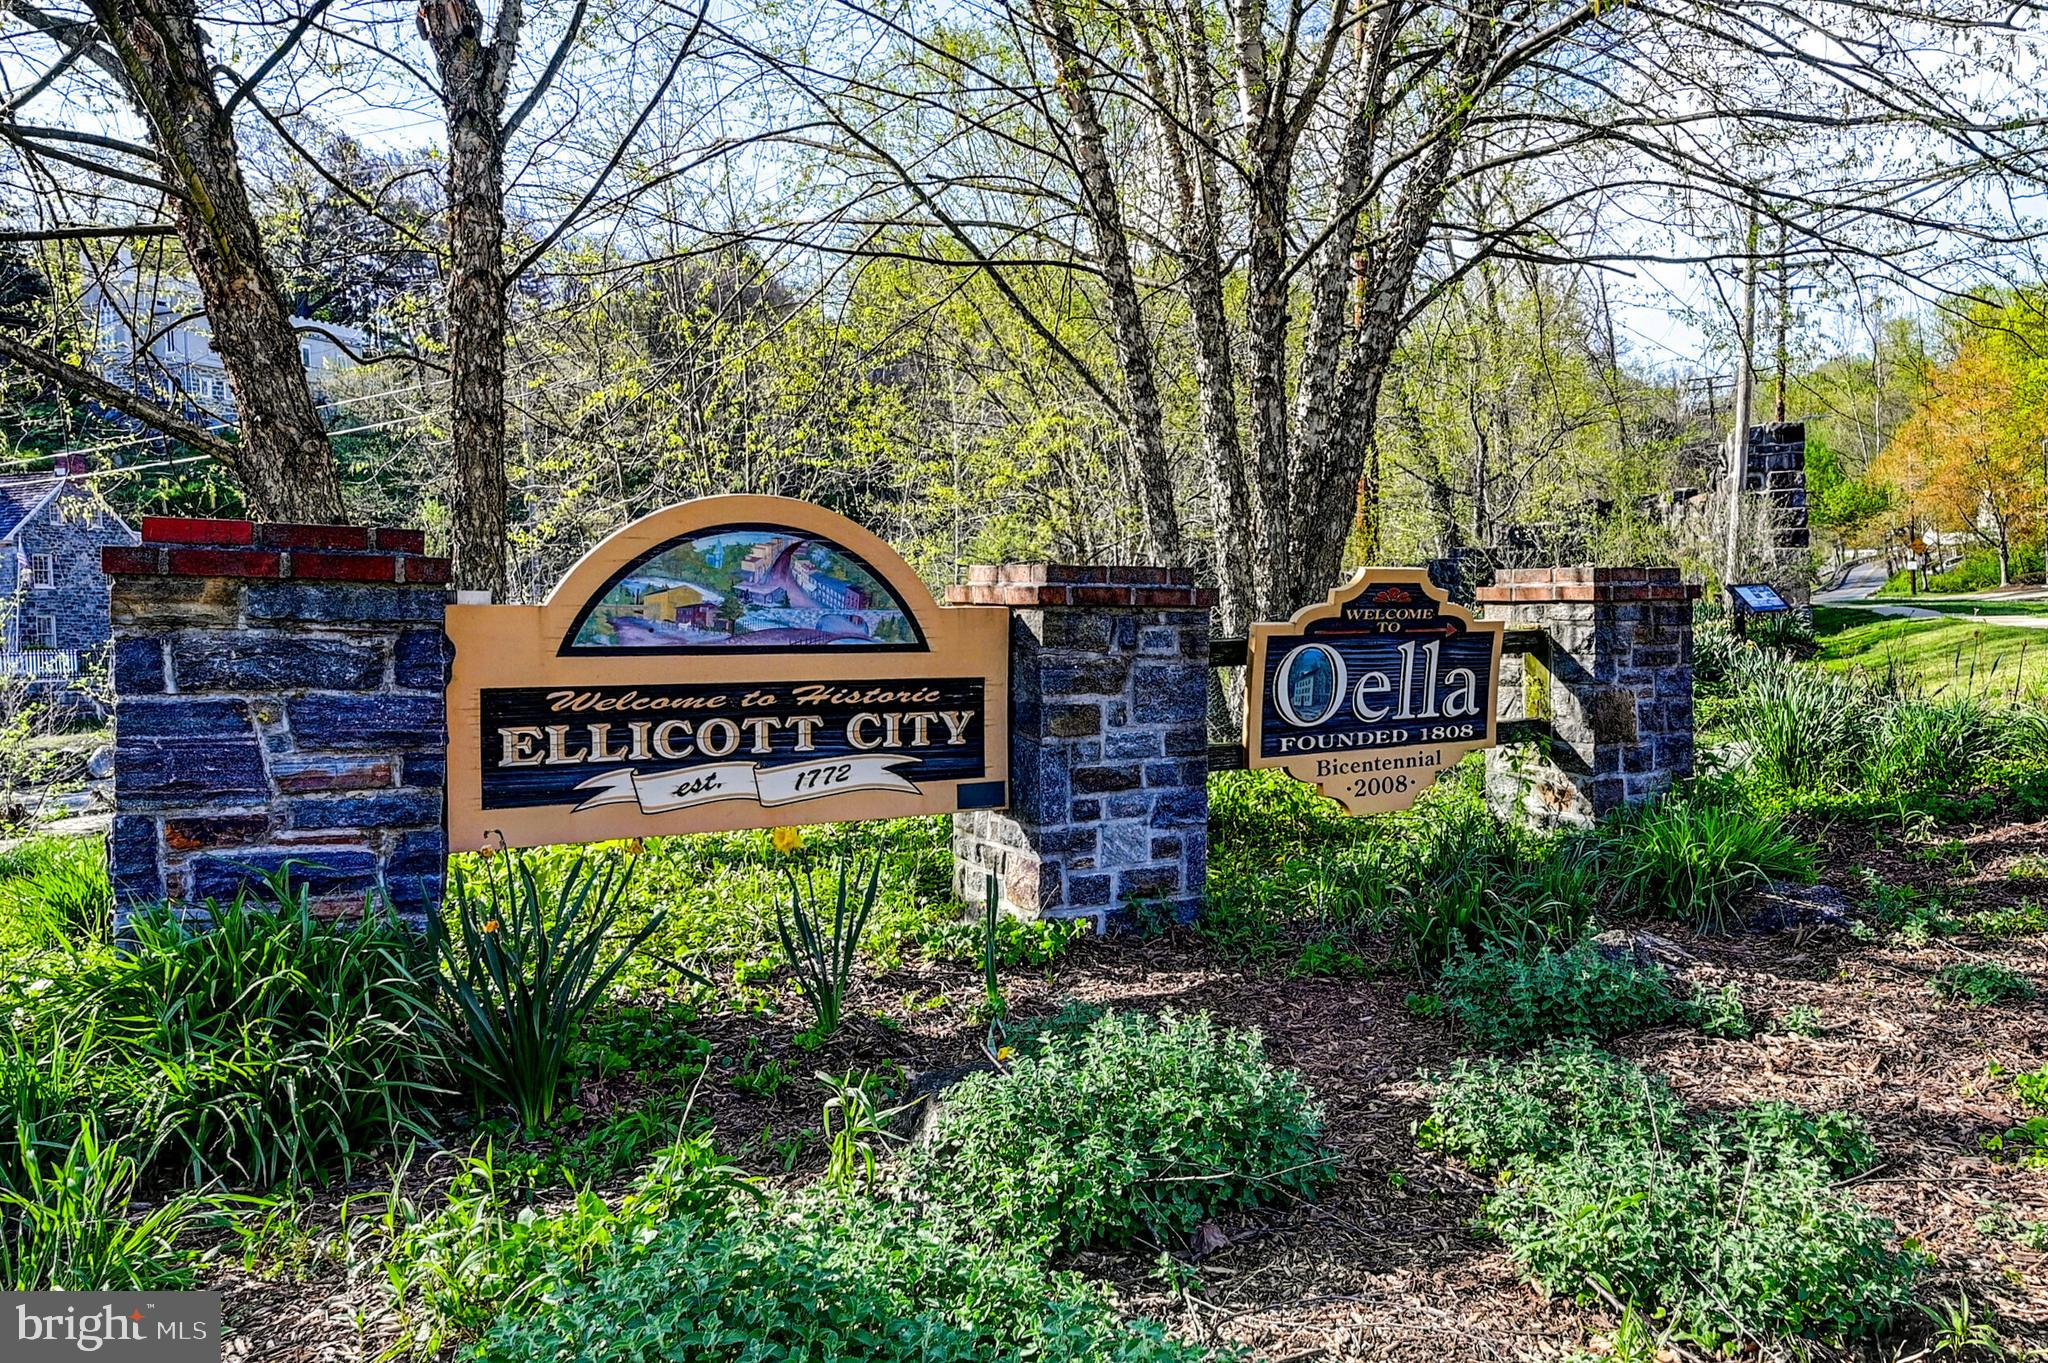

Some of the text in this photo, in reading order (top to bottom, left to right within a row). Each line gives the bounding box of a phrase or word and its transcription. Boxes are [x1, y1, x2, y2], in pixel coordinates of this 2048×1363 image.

[1346, 608, 1434, 620] WELCOME
[1376, 621, 1400, 633] TO
[1272, 640, 1480, 727] Oella
[546, 684, 940, 713] Welcome to Historic
[498, 710, 976, 768] ELLICOTT CITY
[1279, 724, 1474, 752] FOUNDED 1808
[1316, 750, 1442, 777] Bicentennial
[671, 763, 852, 799] est. 1772
